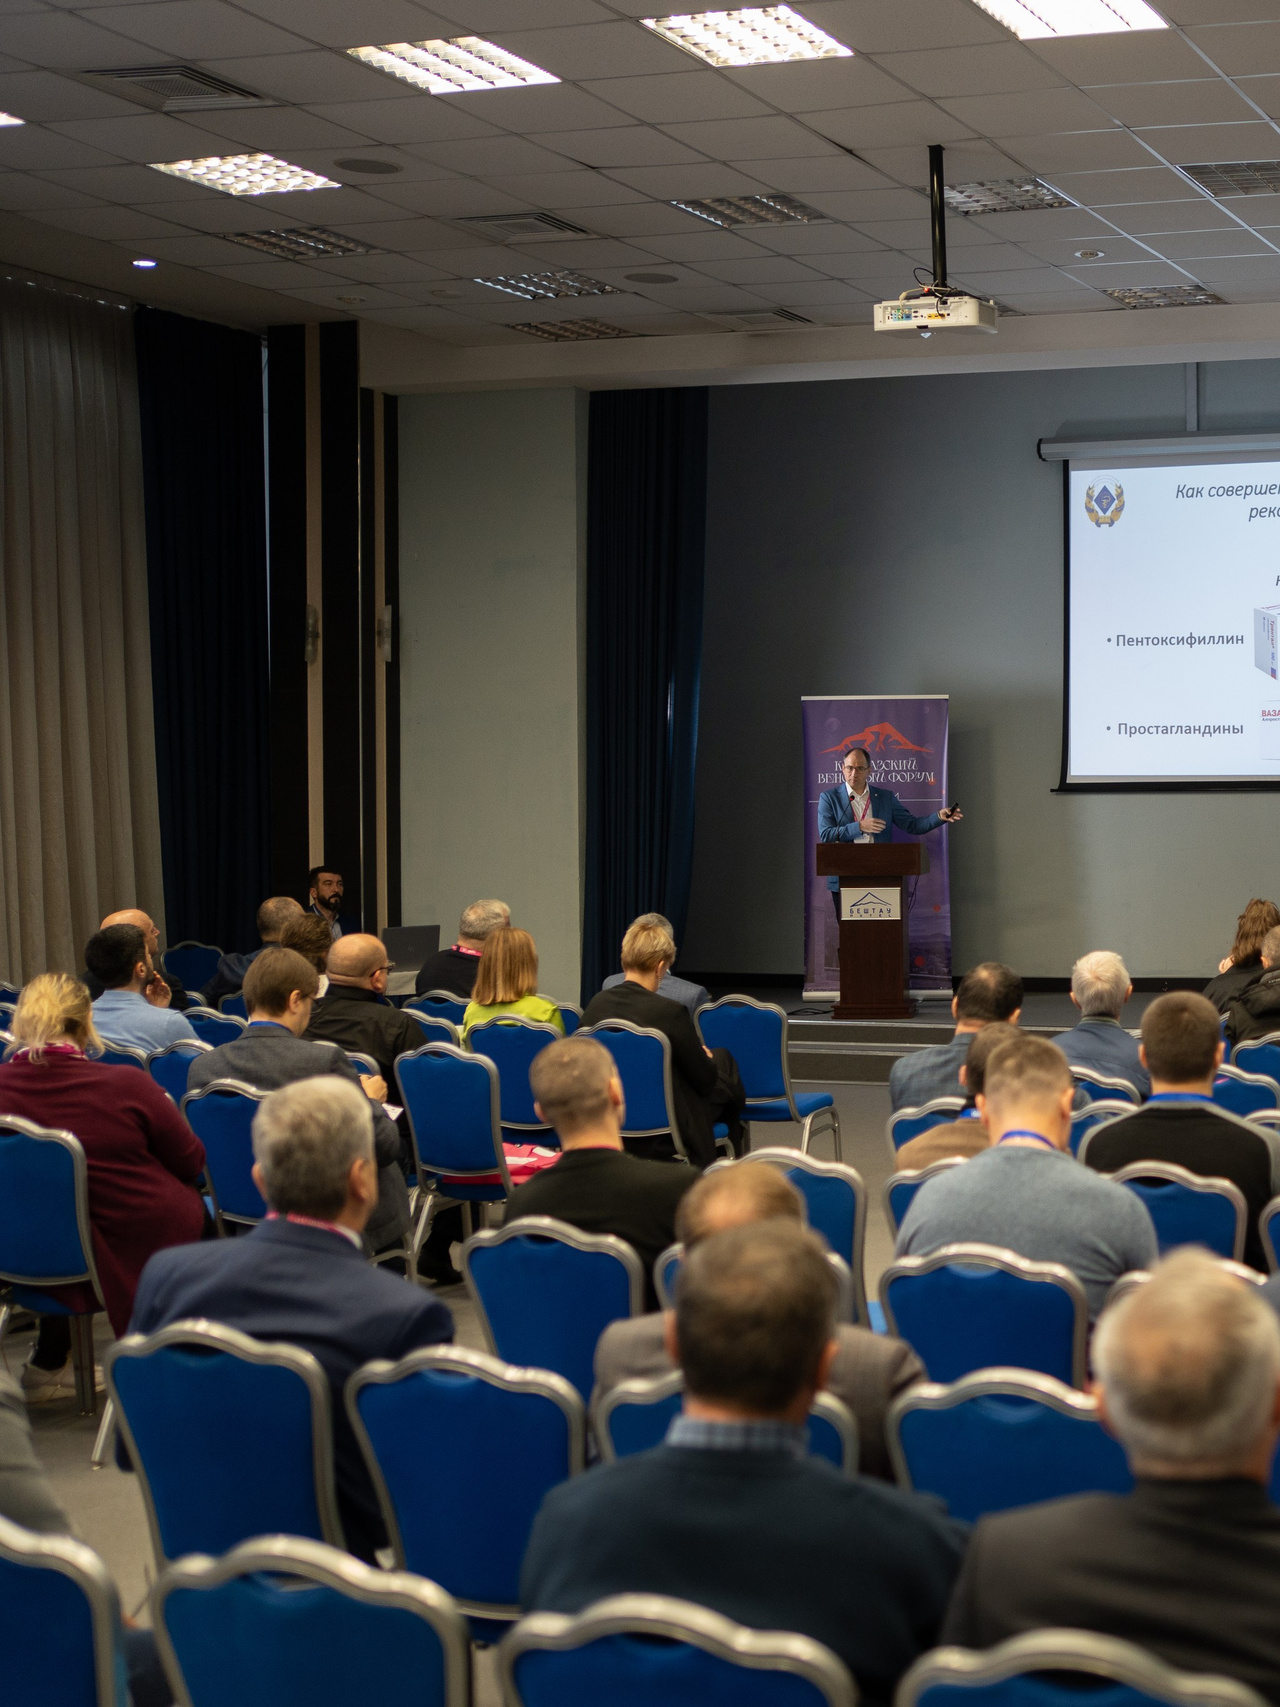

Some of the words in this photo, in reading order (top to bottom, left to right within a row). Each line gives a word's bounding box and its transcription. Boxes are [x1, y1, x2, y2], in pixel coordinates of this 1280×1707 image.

[1175, 484, 1203, 499] Как
[1116, 632, 1244, 648] Пентоксифиллин
[1118, 723, 1244, 738] Простагландины
[835, 758, 918, 772] КАЗСКИЙ
[888, 771, 935, 783] ФОРУМ
